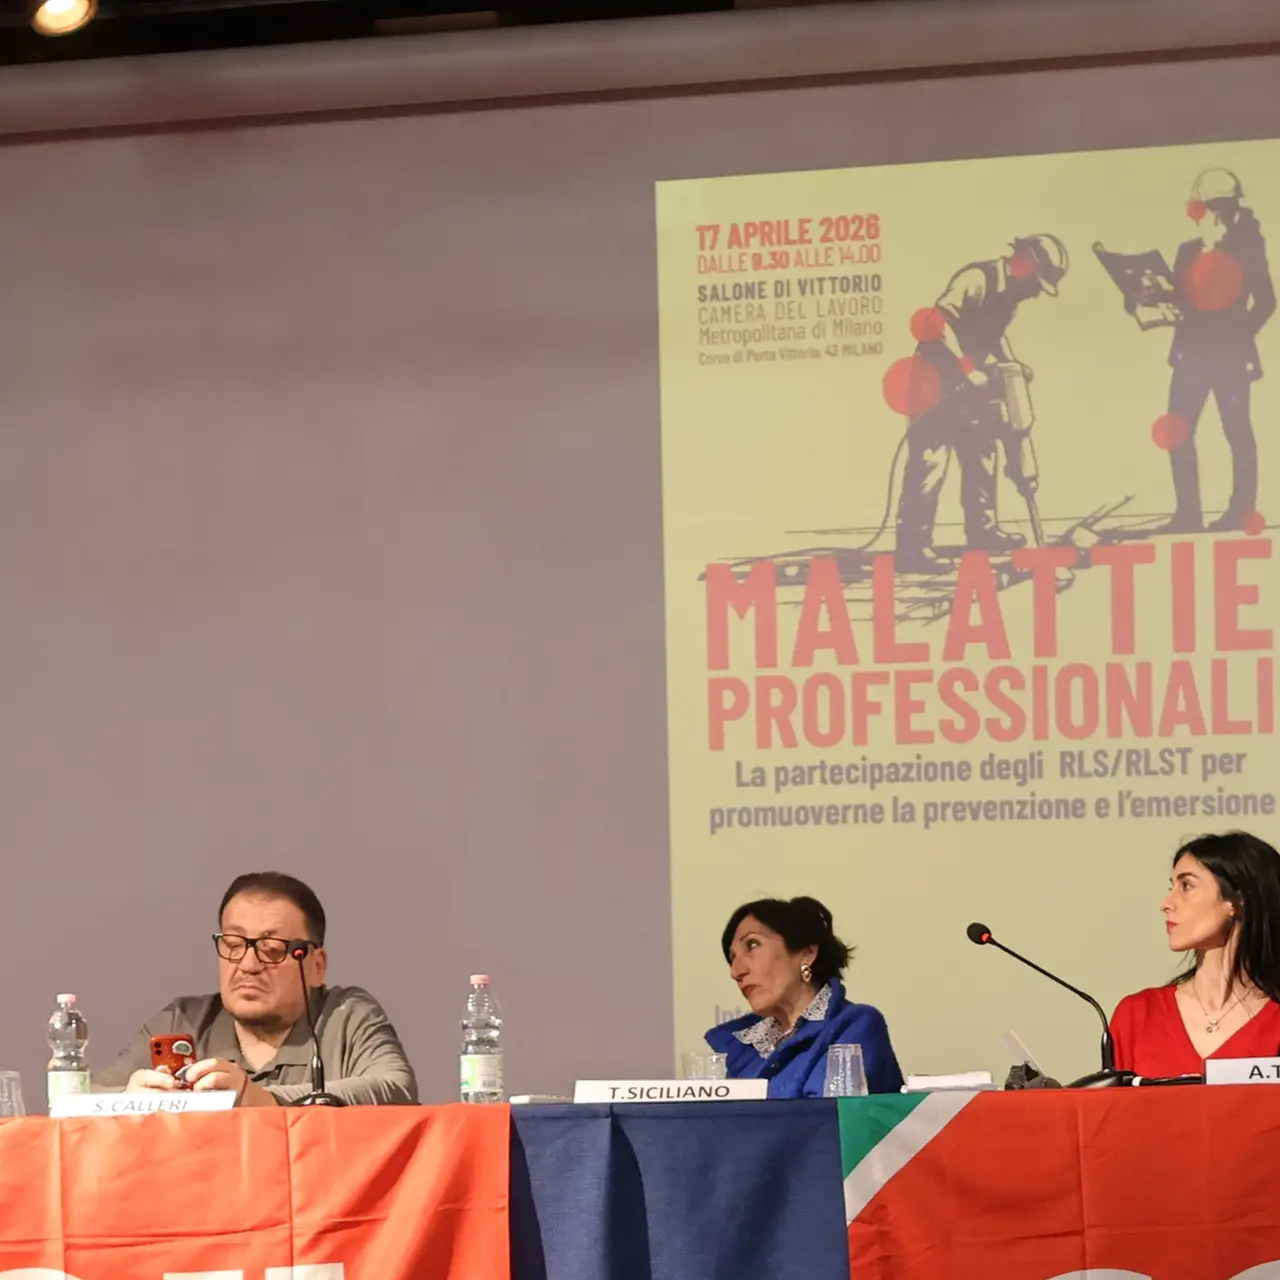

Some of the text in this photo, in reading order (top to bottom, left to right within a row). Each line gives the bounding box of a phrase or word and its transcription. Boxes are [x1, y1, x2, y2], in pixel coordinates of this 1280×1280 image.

[696, 213, 881, 251] 17 APRILE 2026
[697, 252, 748, 274] DALLE
[793, 246, 834, 268] ALLE
[838, 243, 882, 265] 14.00
[697, 274, 882, 303] SALONE DI VITTORIO
[697, 295, 883, 326] CAMERA DEL LAVORO
[698, 317, 883, 347] Metropolitana di Milano
[842, 341, 884, 356] MILANO
[705, 538, 1274, 670] MALATTIE
[706, 657, 1276, 752] PROFESSIONALI
[735, 747, 1247, 793] La partecipazione degli RLS/RLST per
[709, 802, 885, 836] promuoverne
[891, 796, 916, 824] la
[923, 793, 1087, 831] prevenzione
[1094, 796, 1111, 819] e
[94, 1099, 188, 1113] S.CALLERI
[609, 1085, 731, 1100] T.SICILIANO
